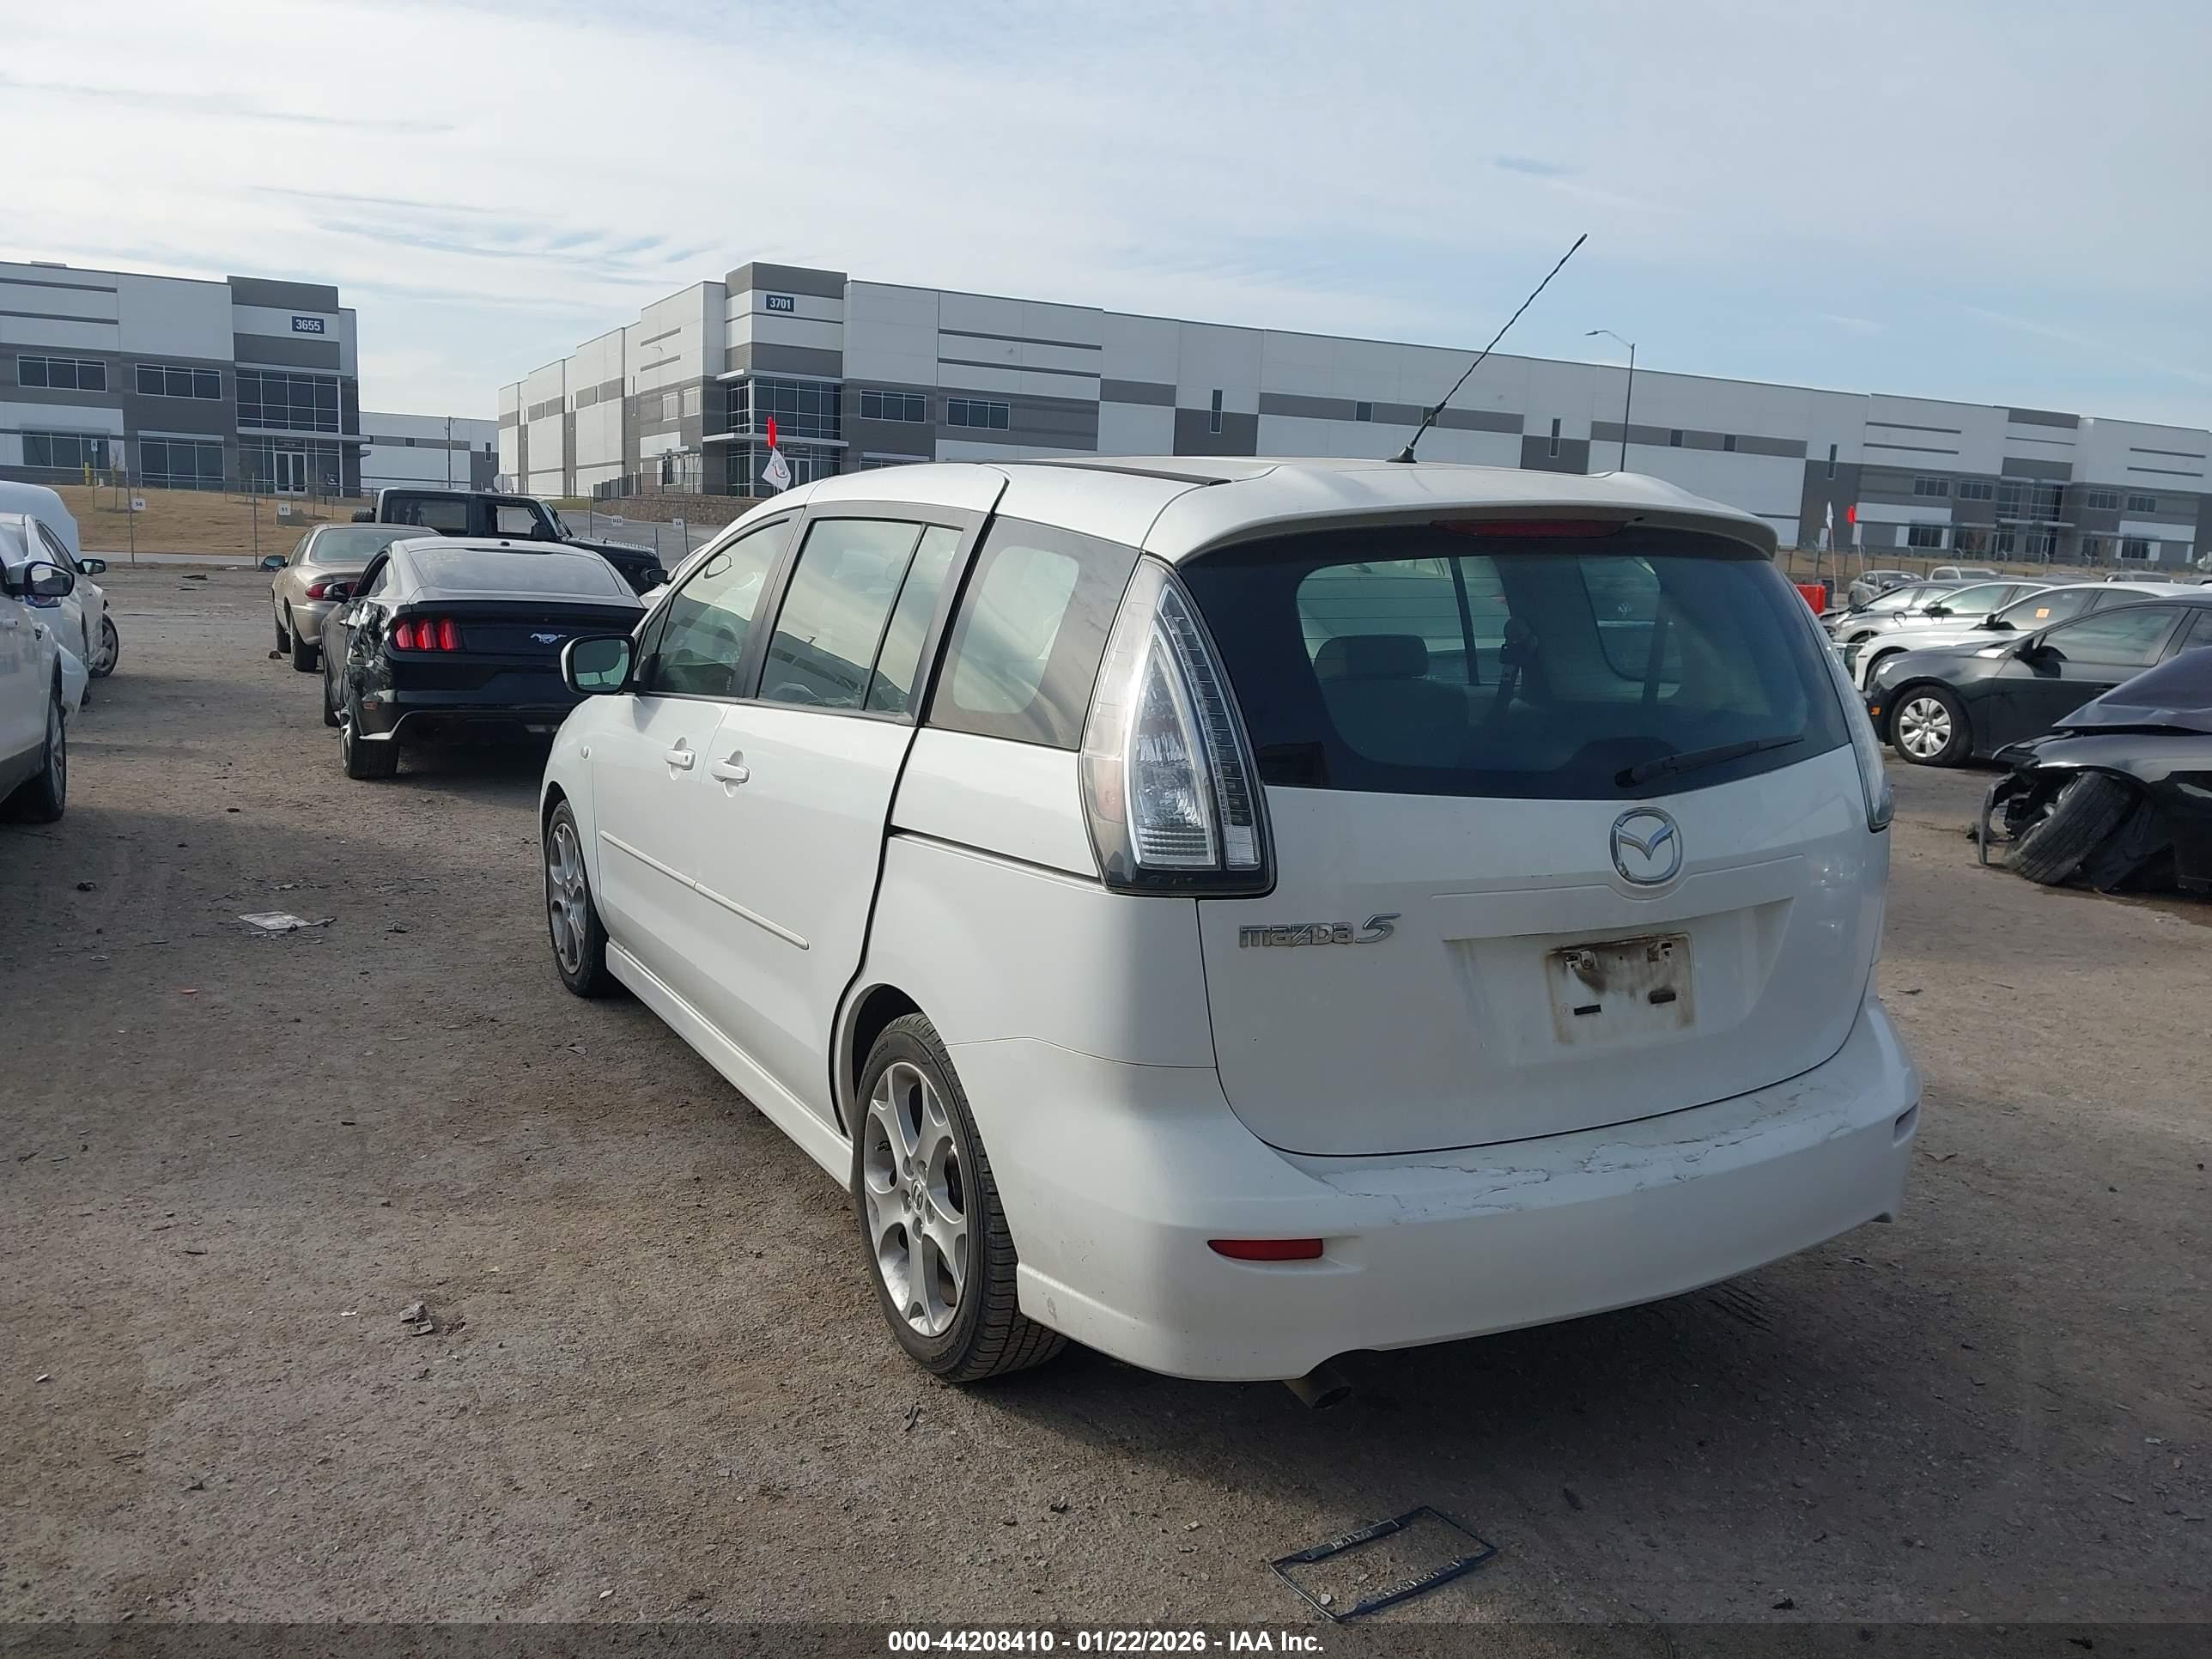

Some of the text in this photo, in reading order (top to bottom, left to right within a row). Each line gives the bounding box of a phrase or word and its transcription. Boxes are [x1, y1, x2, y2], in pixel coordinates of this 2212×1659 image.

[769, 297, 791, 309] 3701
[295, 319, 320, 331] 3655
[1355, 913, 1401, 944] 5
